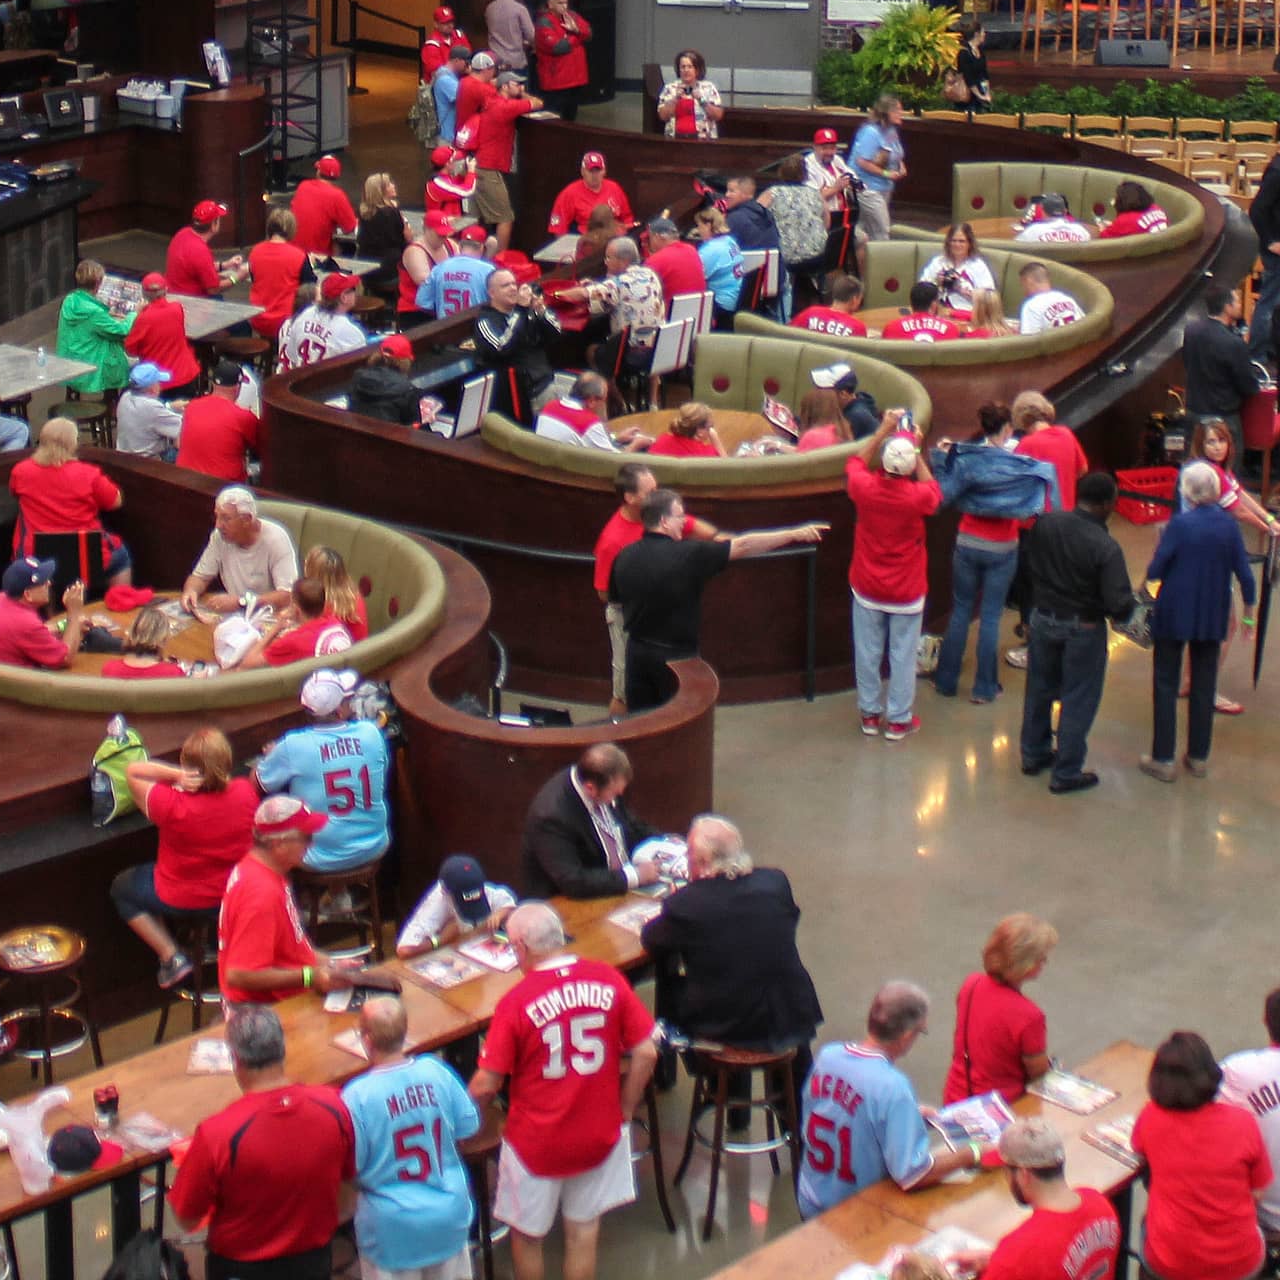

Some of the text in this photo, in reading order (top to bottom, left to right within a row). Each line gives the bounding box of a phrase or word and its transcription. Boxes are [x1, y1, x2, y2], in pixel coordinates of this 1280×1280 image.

[444, 288, 471, 316] 51
[320, 736, 364, 764] McGEE
[322, 764, 372, 817] 51
[525, 980, 616, 1029] EDMONDS
[542, 1011, 605, 1080] 15
[385, 1083, 439, 1120] McGEE
[392, 1116, 444, 1183] 51
[806, 1111, 857, 1184] 51
